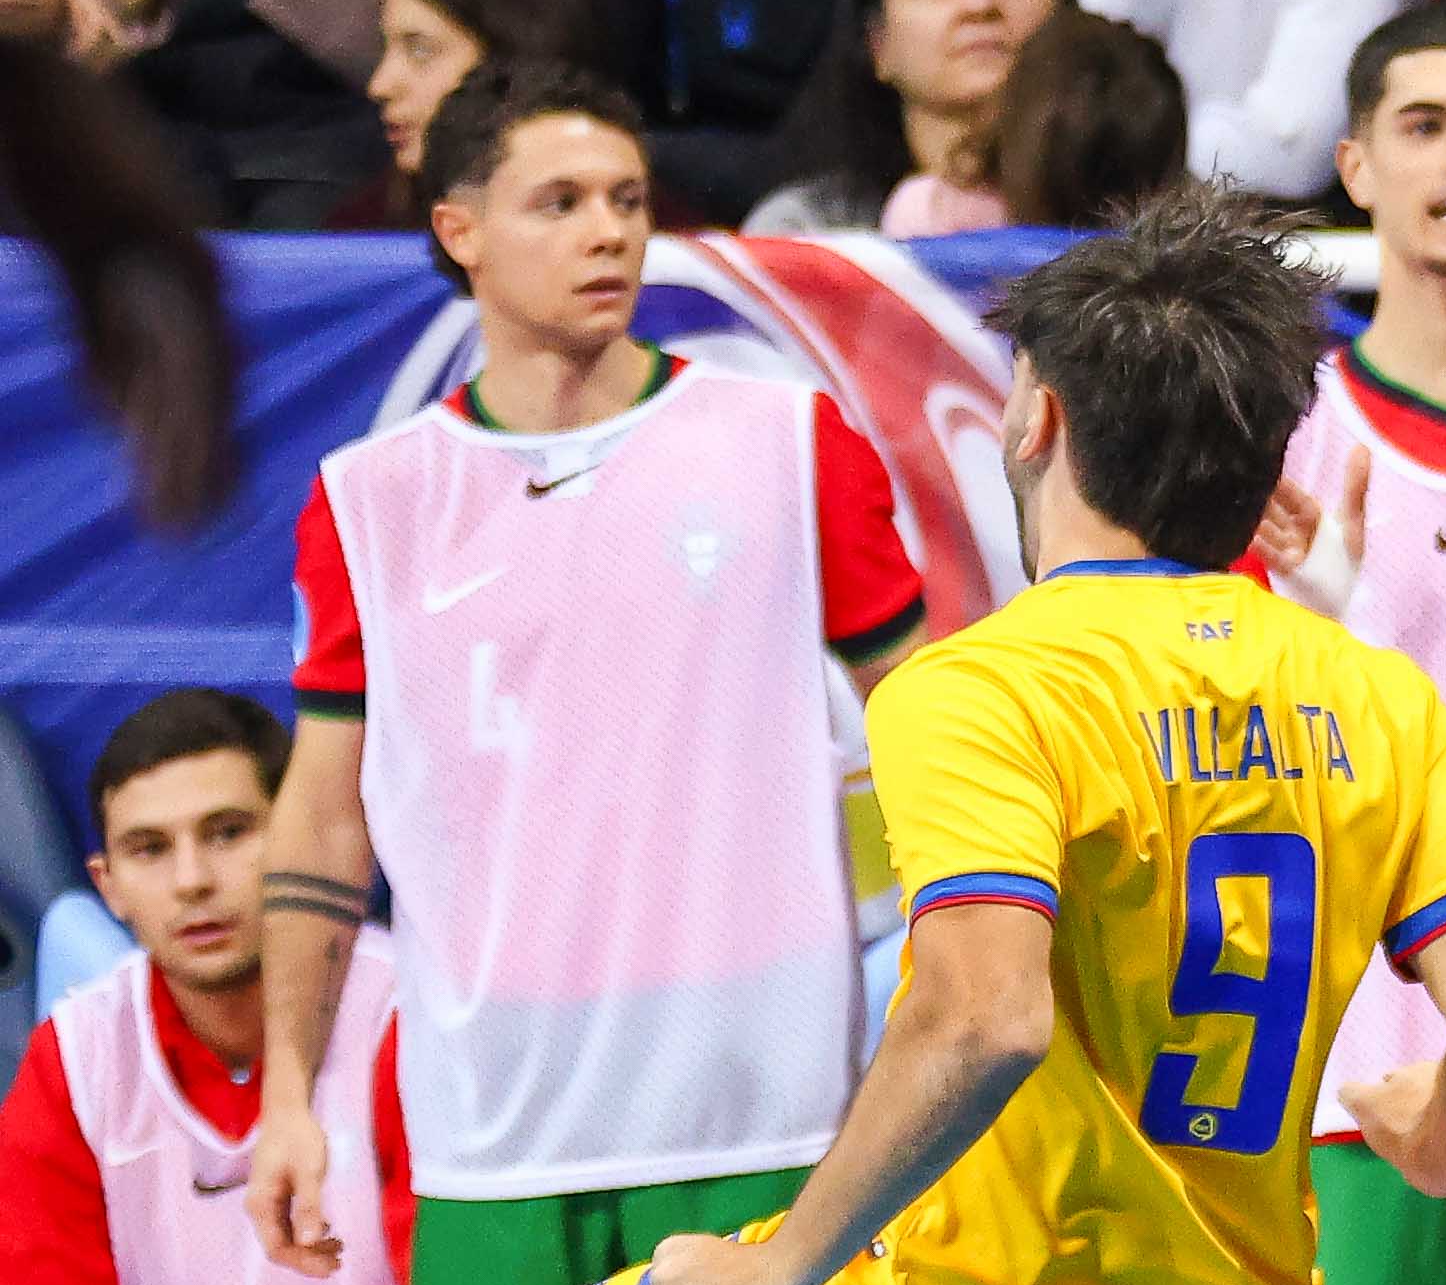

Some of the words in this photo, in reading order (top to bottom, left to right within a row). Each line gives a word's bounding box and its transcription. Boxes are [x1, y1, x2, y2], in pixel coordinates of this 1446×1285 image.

[1185, 620, 1234, 642] FAF
[1138, 704, 1357, 783] VILLALTA
[1140, 830, 1317, 1154] 9
